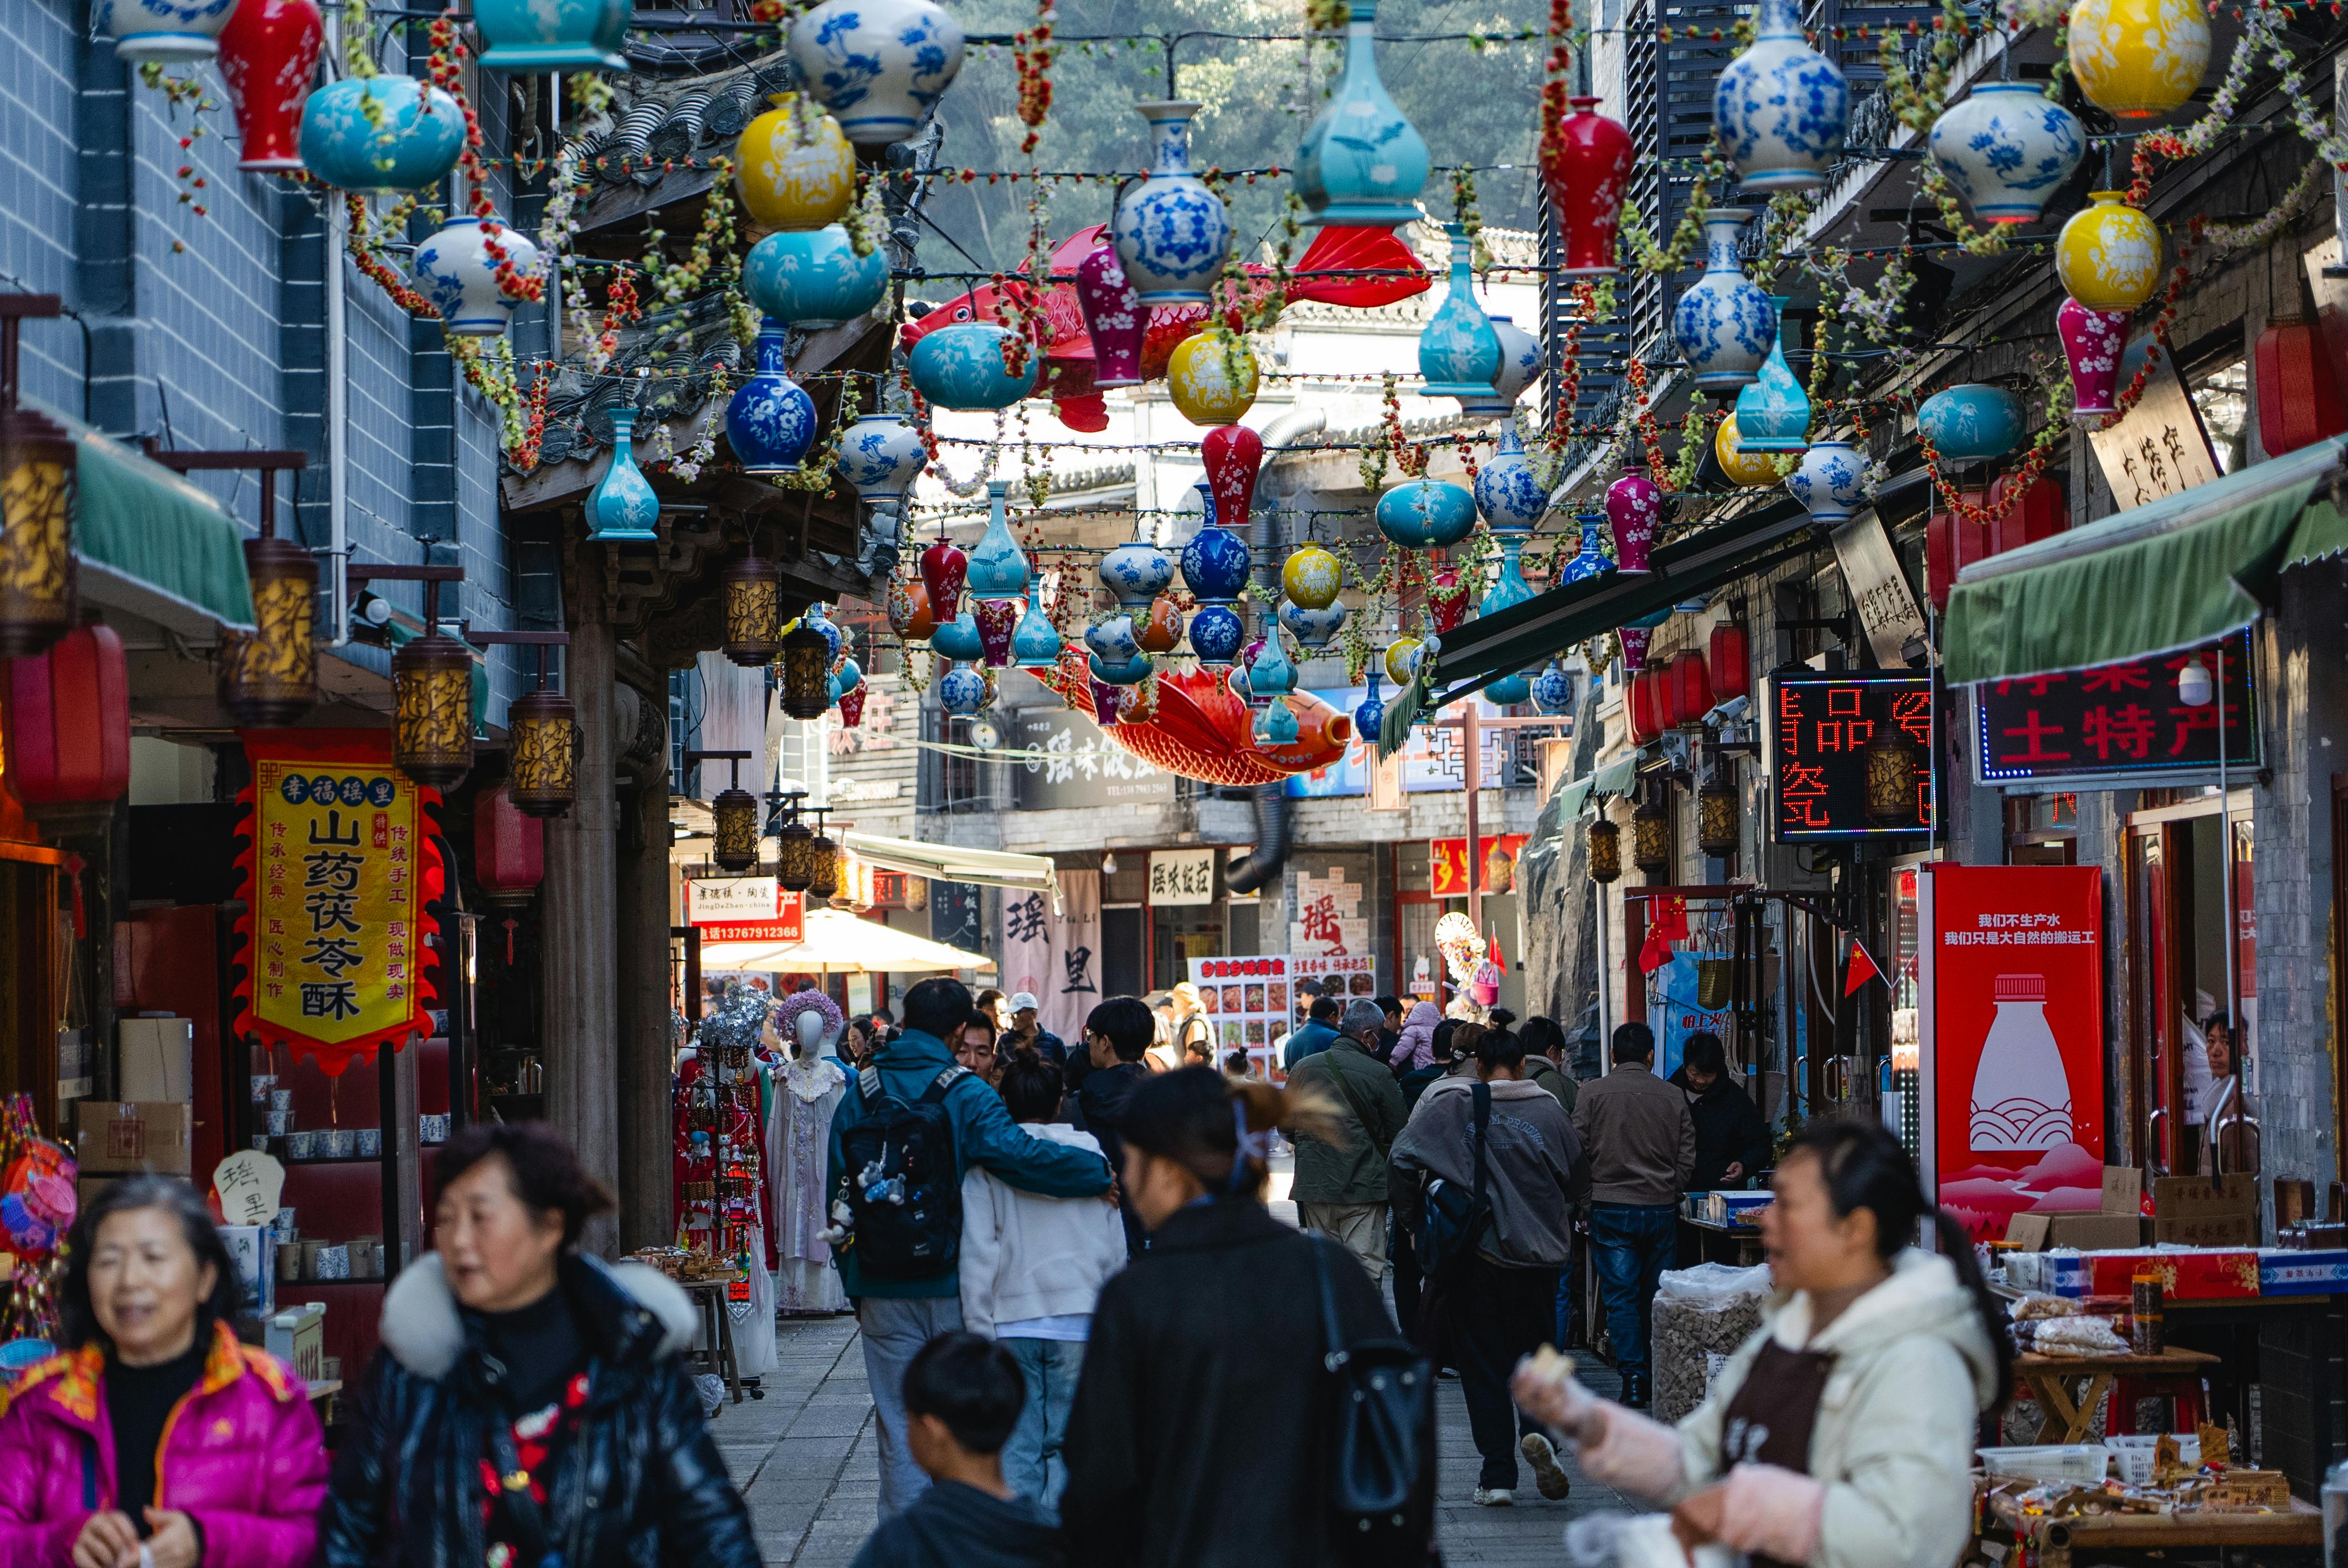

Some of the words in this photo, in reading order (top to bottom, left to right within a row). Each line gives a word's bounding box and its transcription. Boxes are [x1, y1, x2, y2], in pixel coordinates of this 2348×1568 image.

[2000, 704, 2238, 762] 土特产
[282, 776, 392, 804] 幸福瑶里
[374, 815, 387, 845] 特供
[268, 821, 287, 901] 传承经典
[389, 825, 409, 903] 传统手工
[301, 809, 364, 1021] 山药茯苓酥
[1007, 891, 1049, 944] 瑶
[1944, 930, 2095, 946] 我们只是大自然的搬运工
[1978, 912, 2061, 928] 我们不生产水
[266, 919, 285, 998] 匠心制作
[386, 920, 406, 1000] 现做现卖
